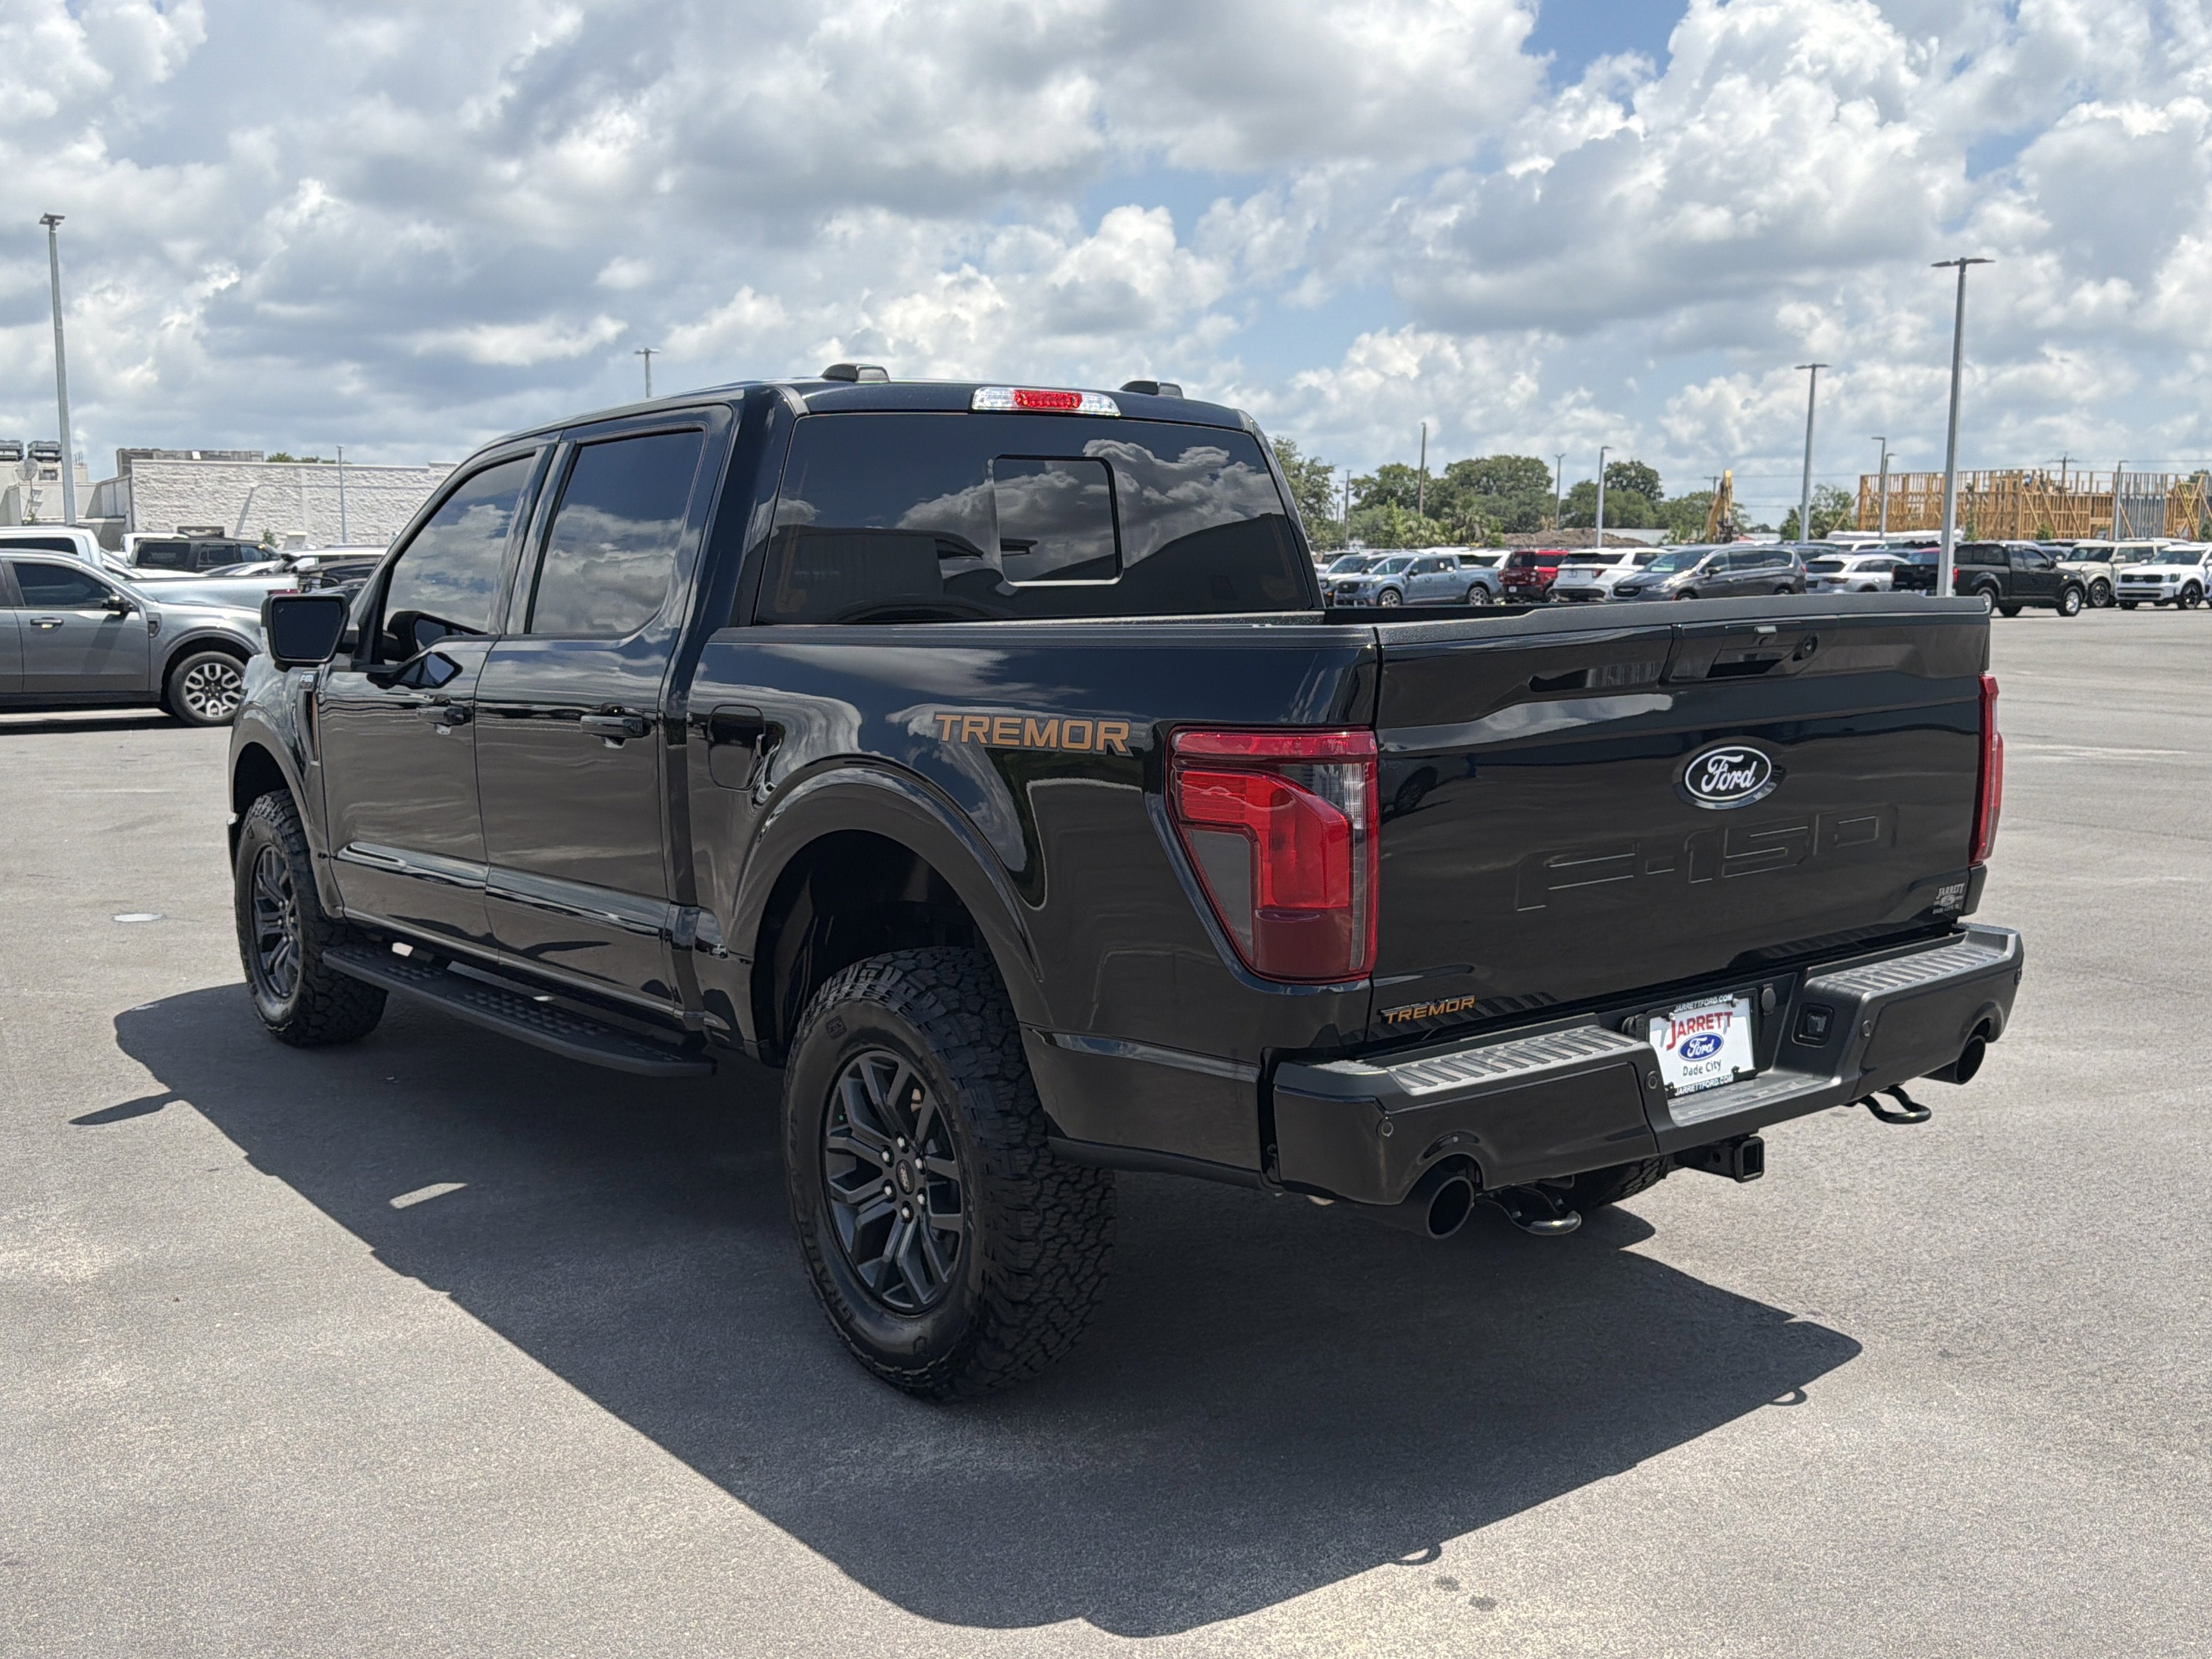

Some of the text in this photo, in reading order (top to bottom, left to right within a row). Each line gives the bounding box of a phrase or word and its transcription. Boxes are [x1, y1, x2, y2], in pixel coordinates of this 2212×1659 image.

[934, 714, 1131, 754] TREMOR
[1701, 754, 1757, 793] Ford
[1515, 803, 1898, 912] F-150
[1380, 994, 1475, 1025] TREMOR
[1674, 993, 1734, 1013] JARRETTFORD.COM
[1666, 1011, 1734, 1051] JARRETT
[1686, 1036, 1715, 1058] Ford
[1682, 1059, 1722, 1076] Dade City
[1674, 1073, 1735, 1096] JARRETTFORD.COM
